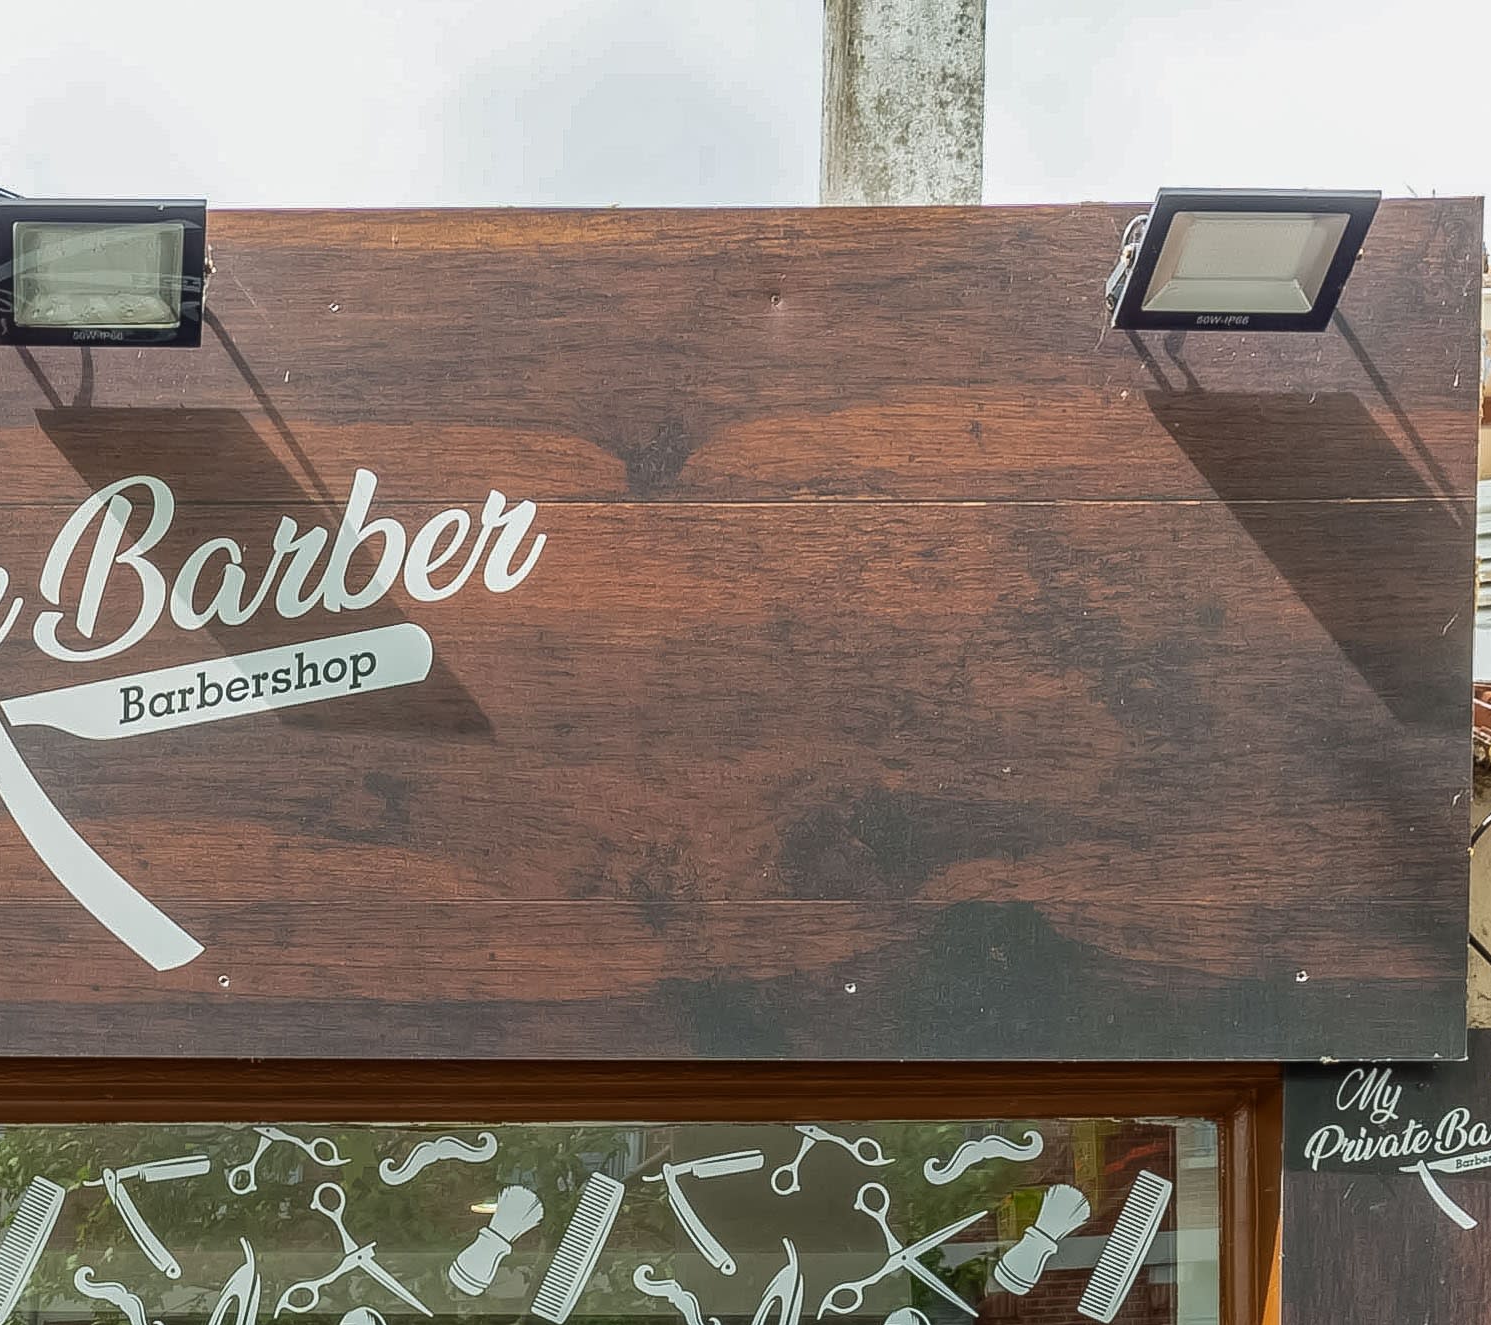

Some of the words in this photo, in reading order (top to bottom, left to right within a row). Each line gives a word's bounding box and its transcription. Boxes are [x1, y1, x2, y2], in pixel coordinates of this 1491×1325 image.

[32, 468, 546, 663] Barber
[119, 647, 378, 726] Barbershop
[1336, 1066, 1402, 1124] My
[1304, 1120, 1432, 1171] Private
